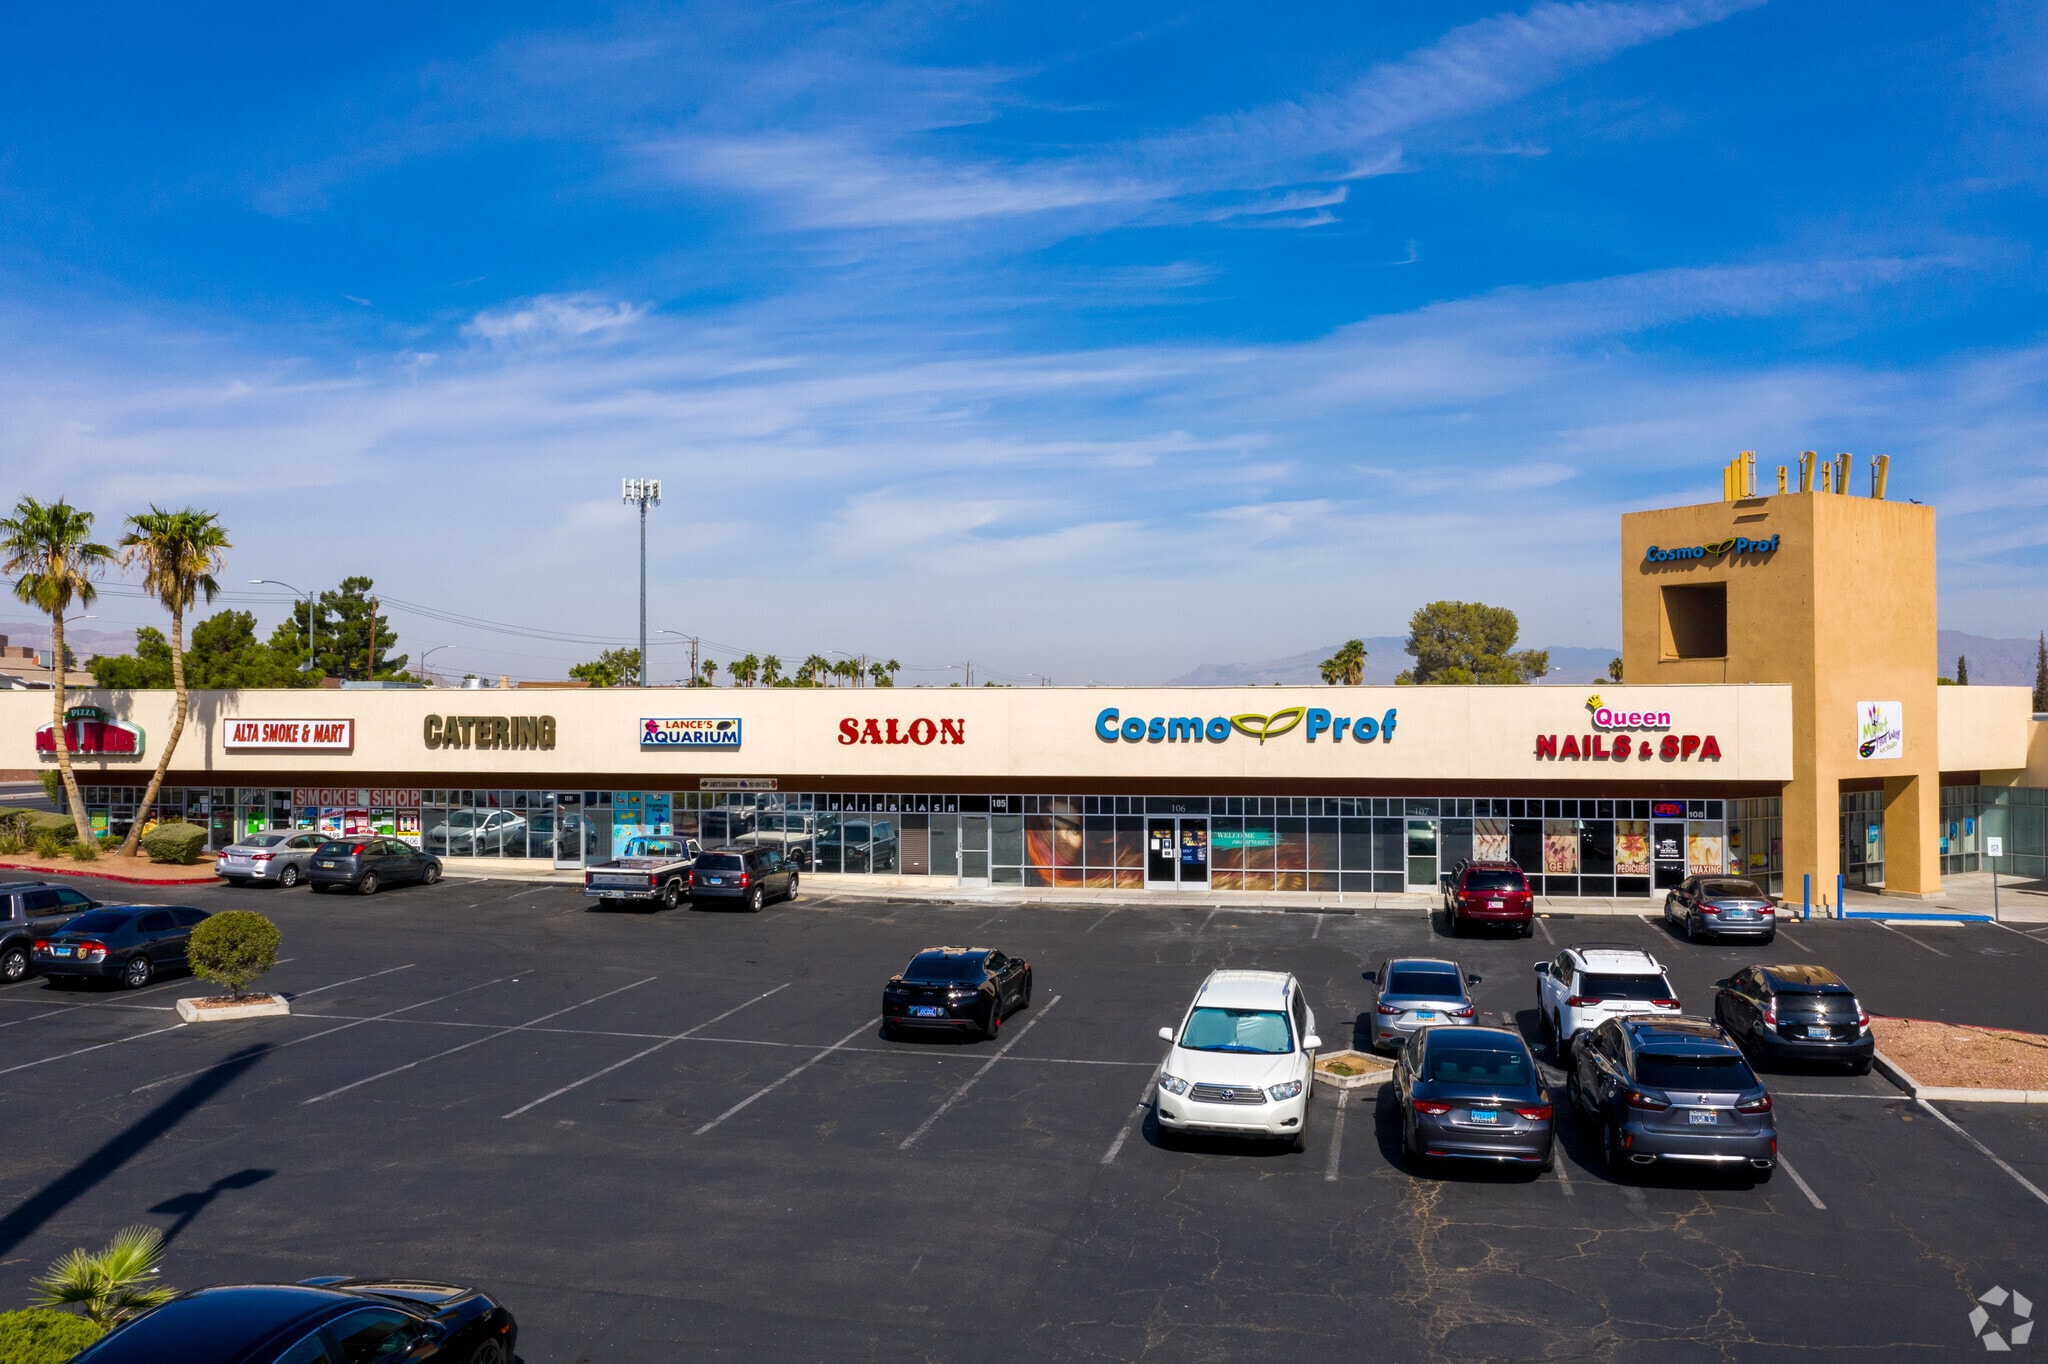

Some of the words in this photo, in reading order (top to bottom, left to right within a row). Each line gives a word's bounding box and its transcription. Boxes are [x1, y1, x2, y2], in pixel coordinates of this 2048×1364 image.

[1646, 545, 1704, 562] Cosmo
[1736, 534, 1780, 554] Prof
[71, 708, 96, 717] PIZZA
[1595, 708, 1671, 726] Queen
[665, 720, 713, 729] LANCE'S
[1095, 707, 1232, 741] Cosmo
[1307, 708, 1397, 741] Prof
[233, 723, 259, 742] ALTA
[262, 723, 299, 743] SMOKE
[302, 724, 311, 743] &
[313, 724, 345, 743] MART
[423, 714, 556, 748] CATERING
[642, 731, 737, 743] AQUARIUM
[838, 718, 965, 745] SALON
[1536, 735, 1632, 758] NAILS
[1639, 740, 1653, 757] &
[1660, 735, 1722, 758] SPA
[296, 789, 356, 806] SMOKE
[372, 790, 420, 806] SHOP
[992, 799, 1006, 808] 105
[906, 803, 955, 812] LASH
[1172, 804, 1186, 812] 106
[1415, 807, 1430, 815] 107
[1654, 803, 1681, 815] OPEN
[1549, 862, 1568, 872] GEL
[1617, 864, 1649, 873] PEDICURE
[1690, 865, 1722, 874] WAXING
